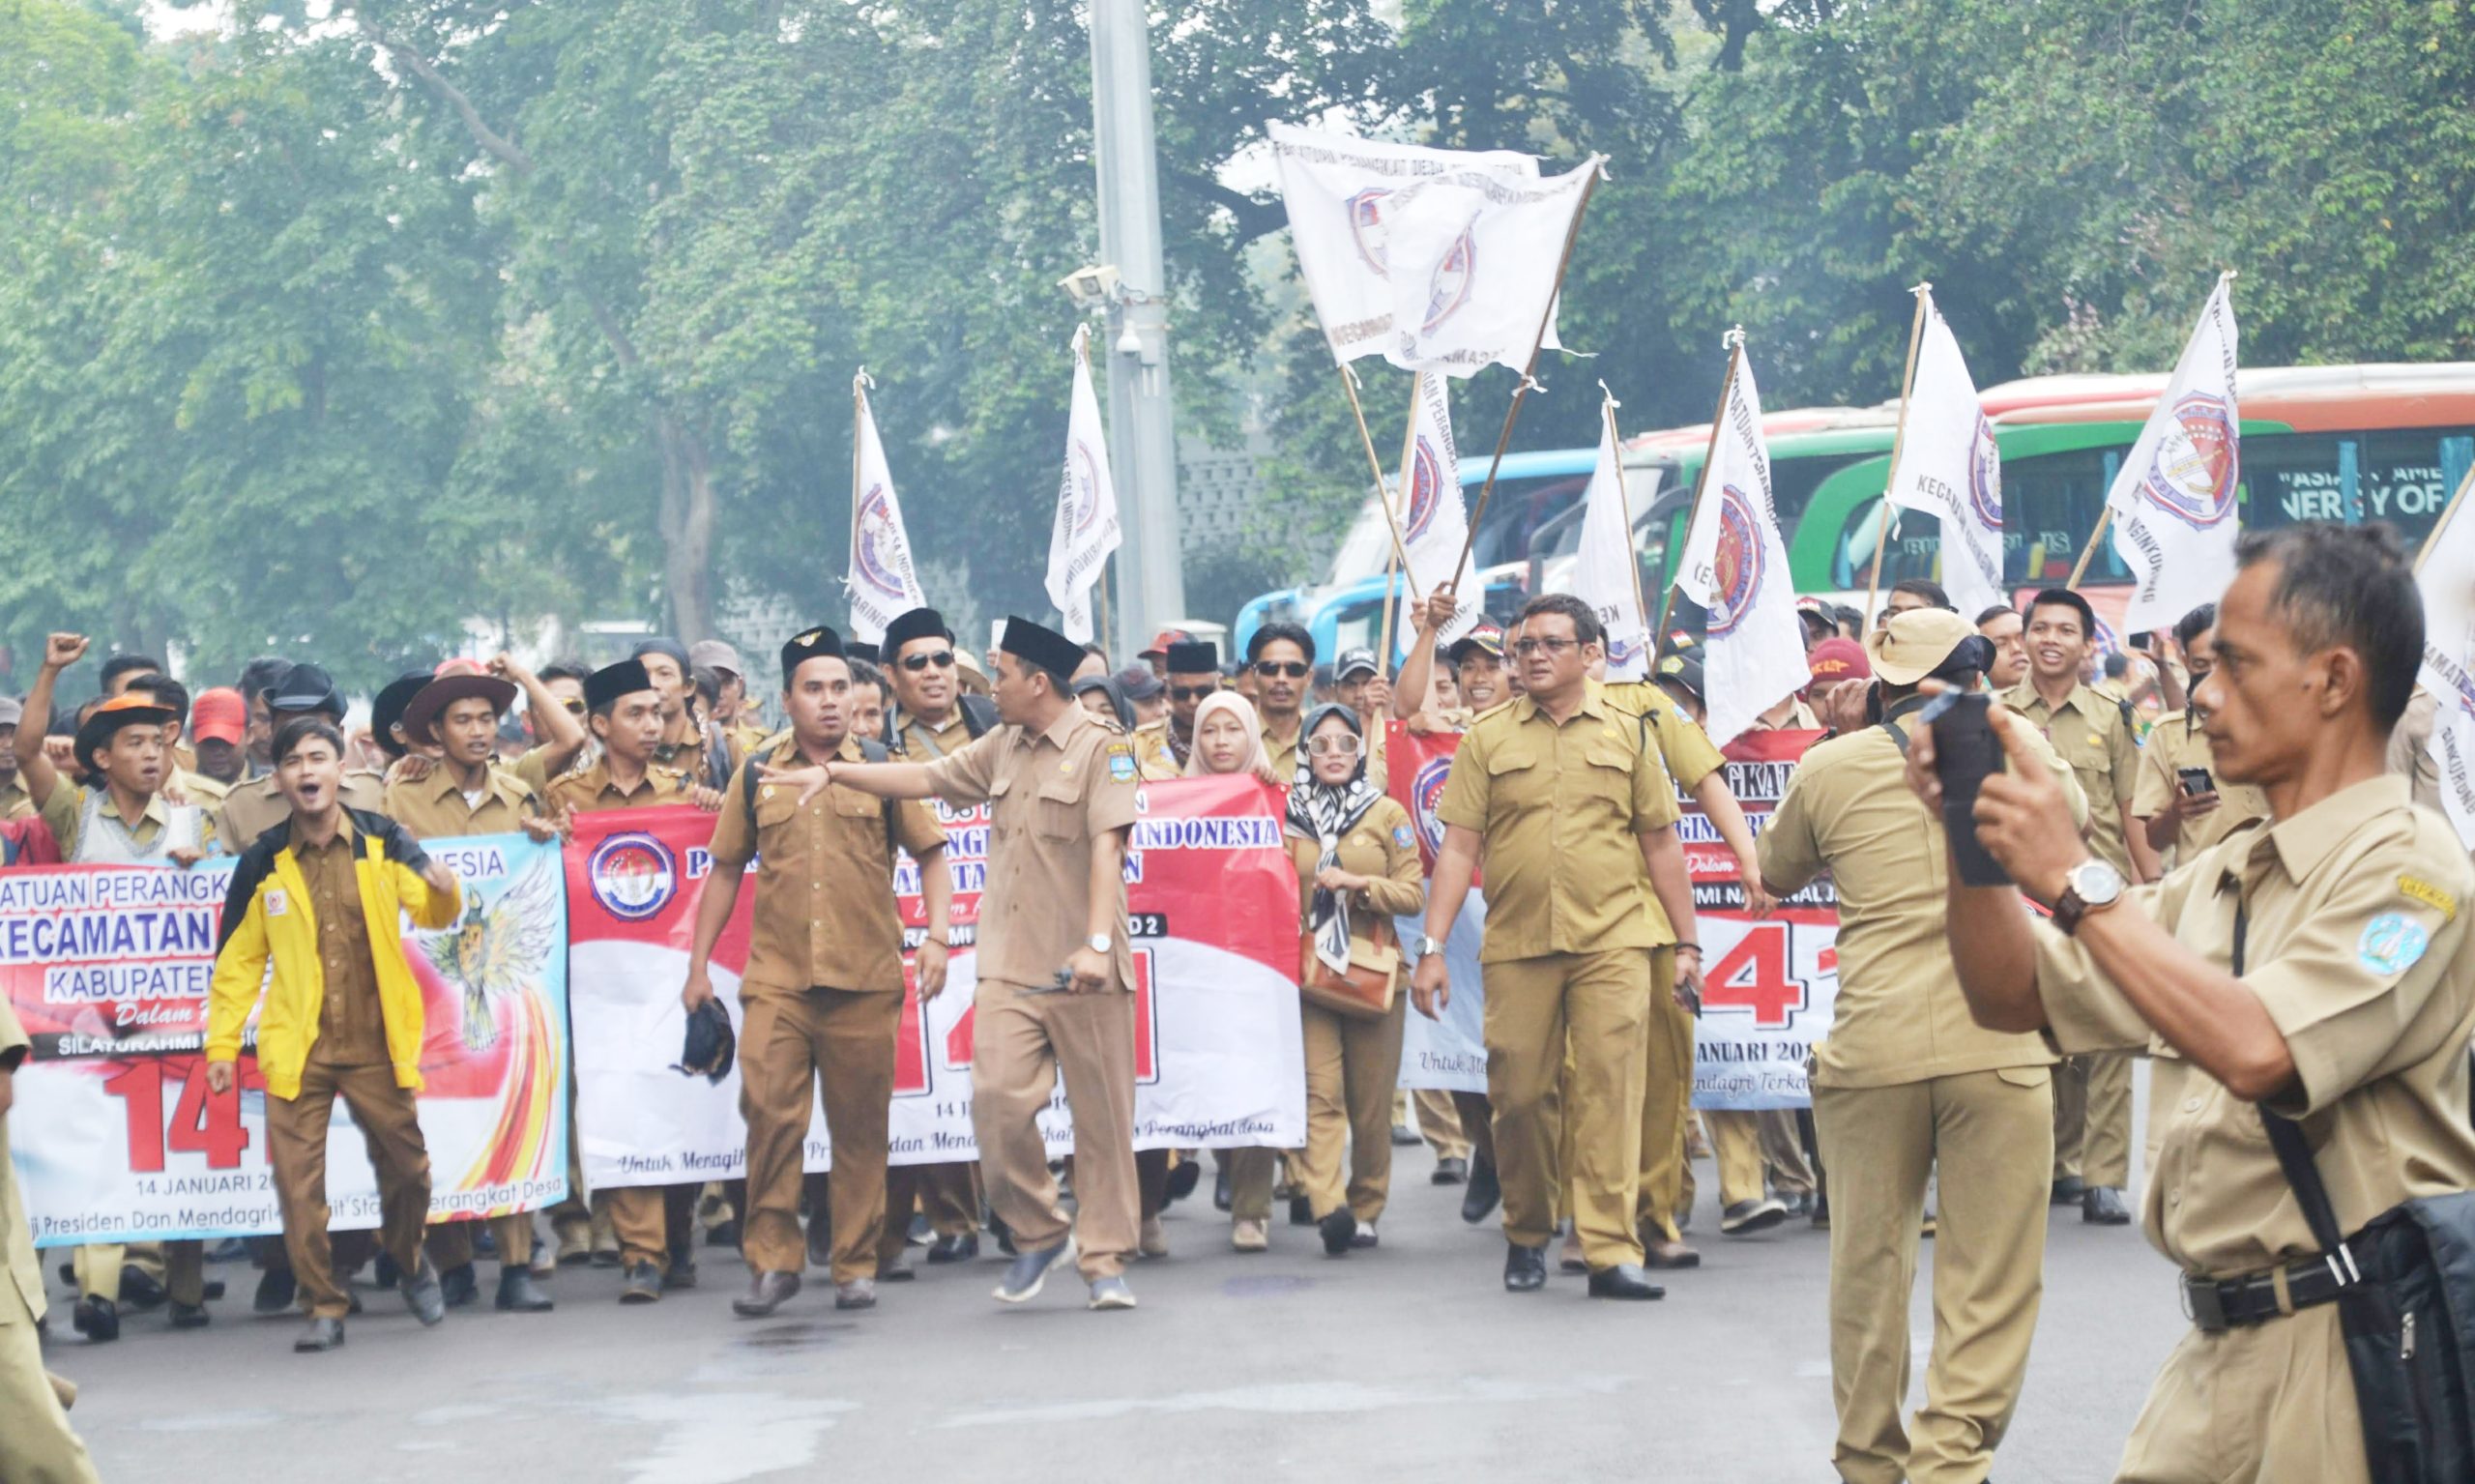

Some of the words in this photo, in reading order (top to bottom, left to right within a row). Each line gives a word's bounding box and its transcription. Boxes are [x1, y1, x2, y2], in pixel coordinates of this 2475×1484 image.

[2397, 482, 2444, 515] OF
[1133, 819, 1281, 848] INDONESIA
[97, 872, 229, 906] PERANGK
[1146, 916, 1159, 936] 2
[114, 1003, 193, 1027] Dalam
[1697, 1042, 1769, 1063] ANUARI
[888, 1136, 924, 1153] dan
[137, 1179, 158, 1196] 14
[163, 1175, 252, 1196] JANUARI
[44, 1208, 125, 1235] Presiden
[131, 1207, 171, 1229] Dan
[178, 1203, 273, 1233] Mendagri
[430, 1184, 517, 1213] erangkat
